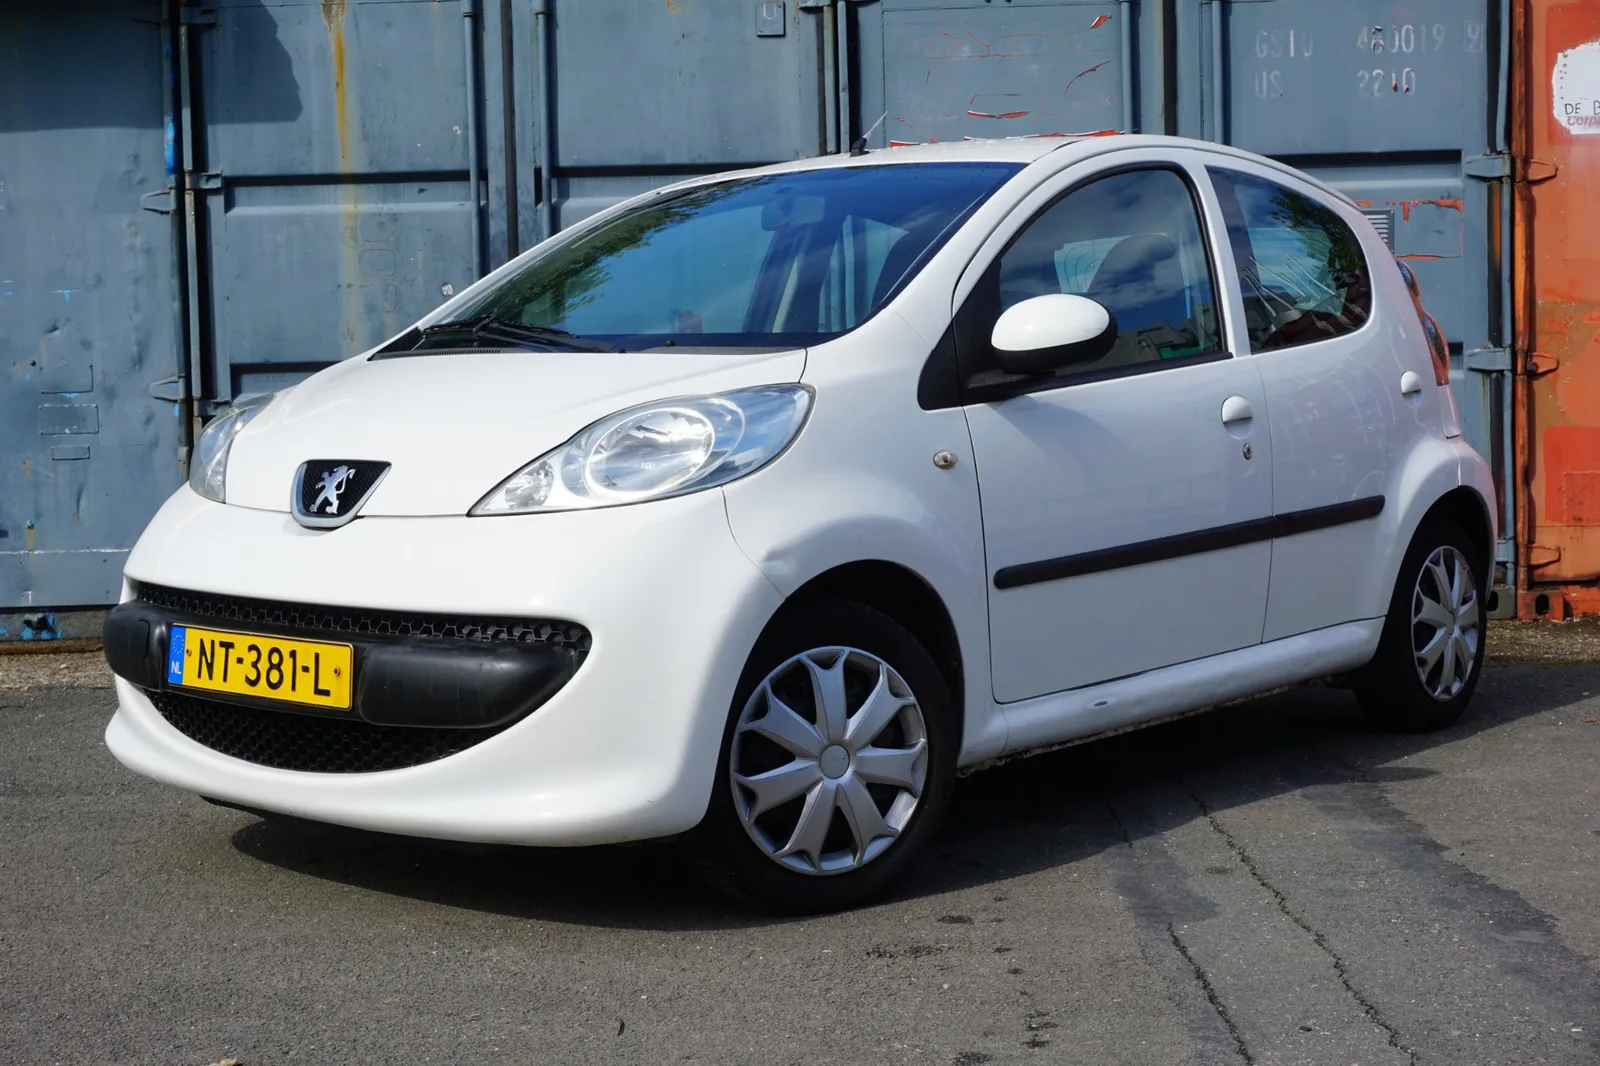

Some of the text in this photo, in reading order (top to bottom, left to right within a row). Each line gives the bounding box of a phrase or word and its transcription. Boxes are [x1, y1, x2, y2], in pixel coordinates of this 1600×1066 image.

[1255, 67, 1417, 98] US 2210
[1564, 102, 1581, 115] DE
[171, 660, 182, 675] NL
[197, 638, 331, 697] NT-381-L
